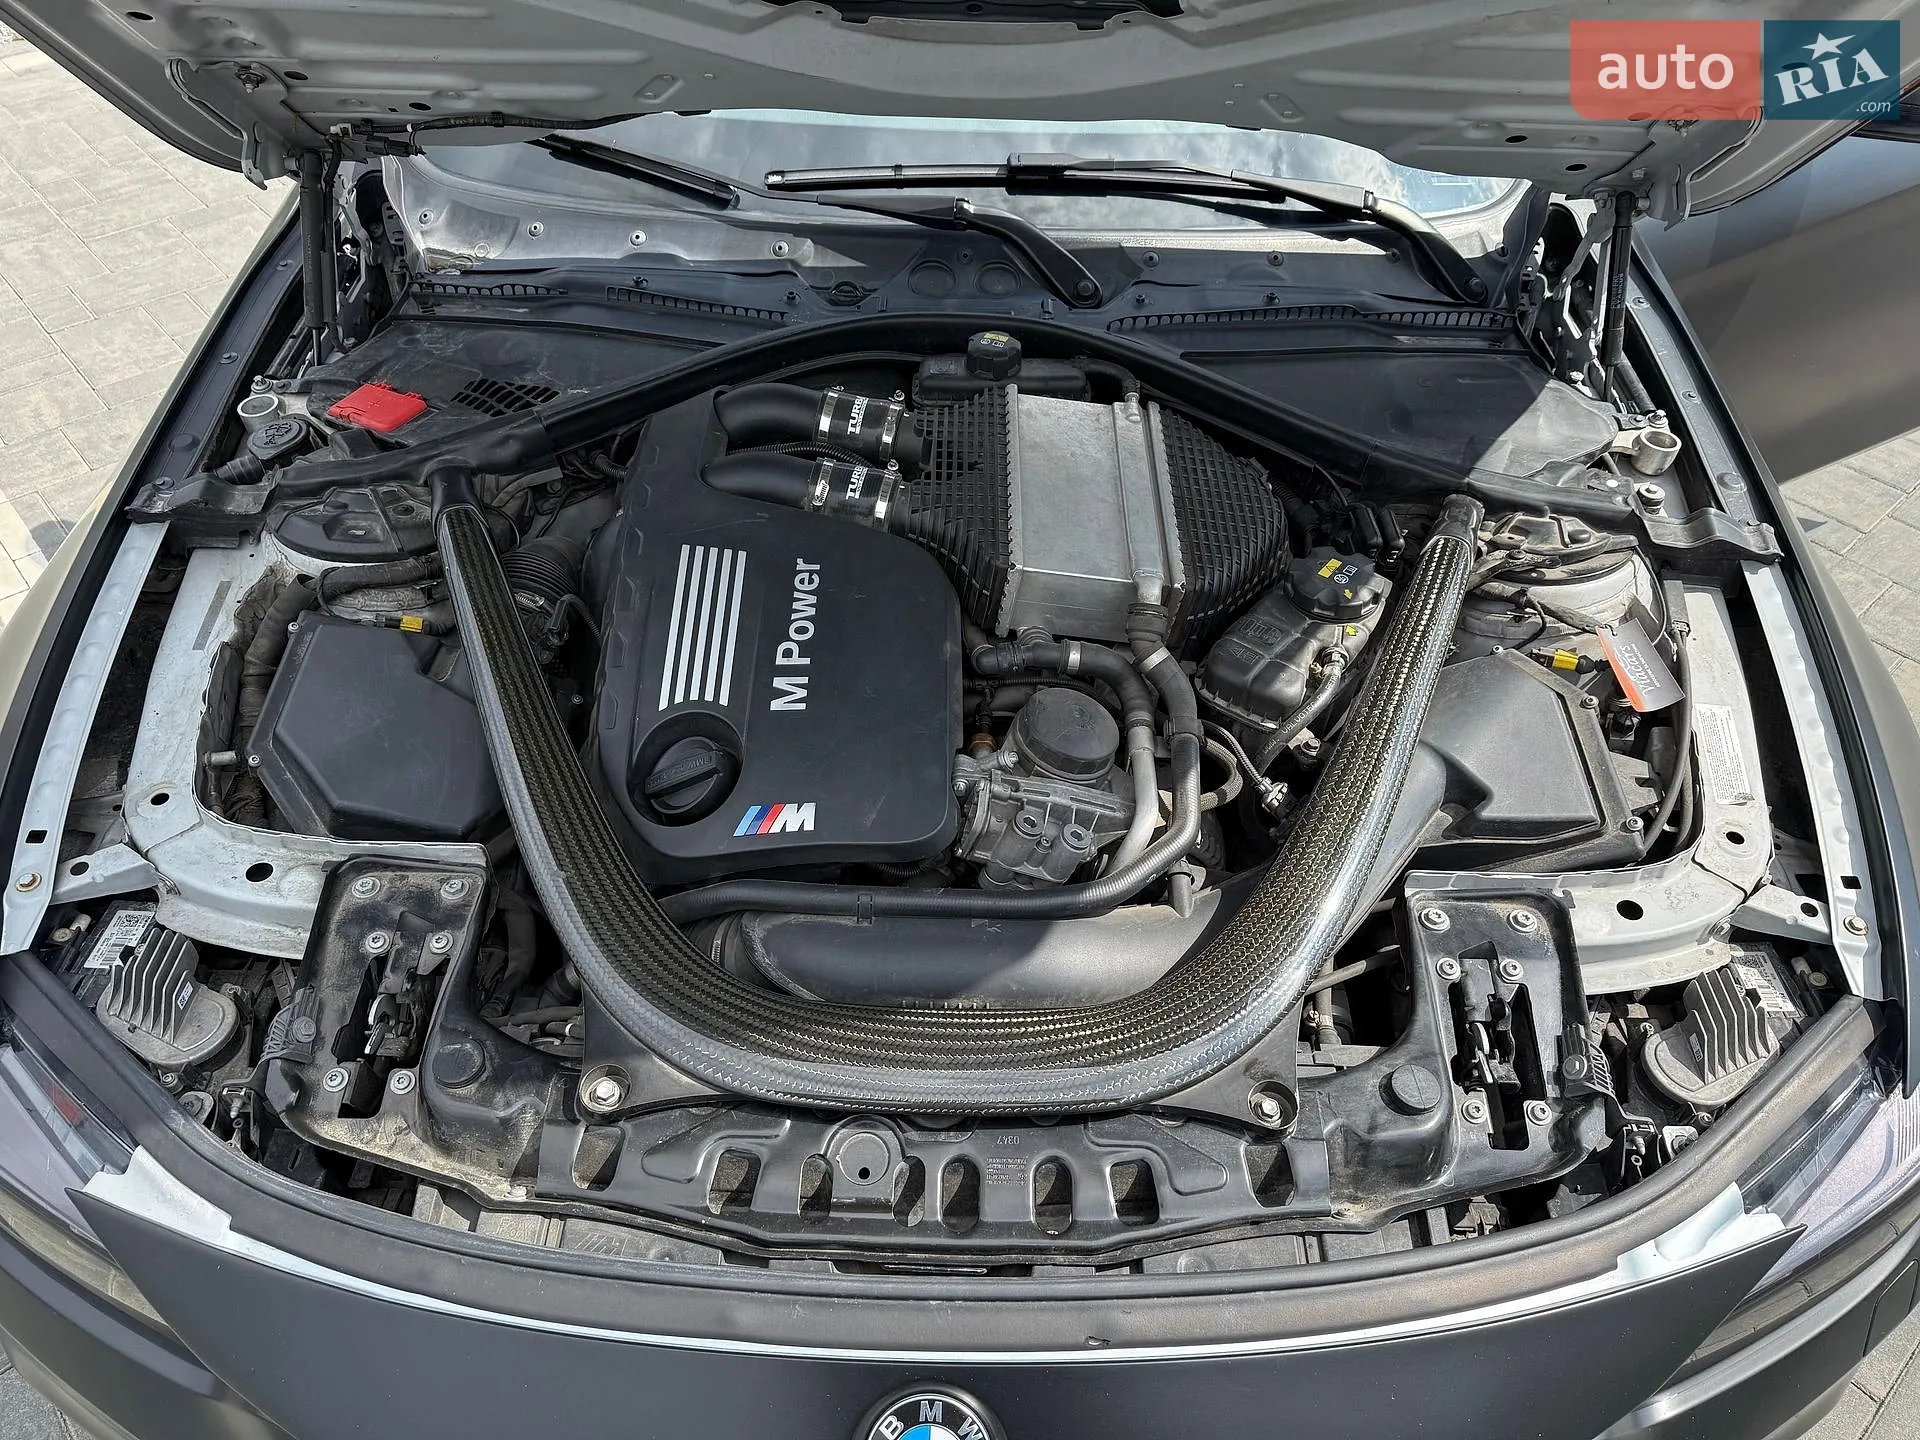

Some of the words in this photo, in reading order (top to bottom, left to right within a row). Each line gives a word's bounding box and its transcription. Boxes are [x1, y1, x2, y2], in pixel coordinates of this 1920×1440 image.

[847, 395, 866, 435] TURB
[775, 558, 821, 665] Power
[770, 677, 809, 711] M
